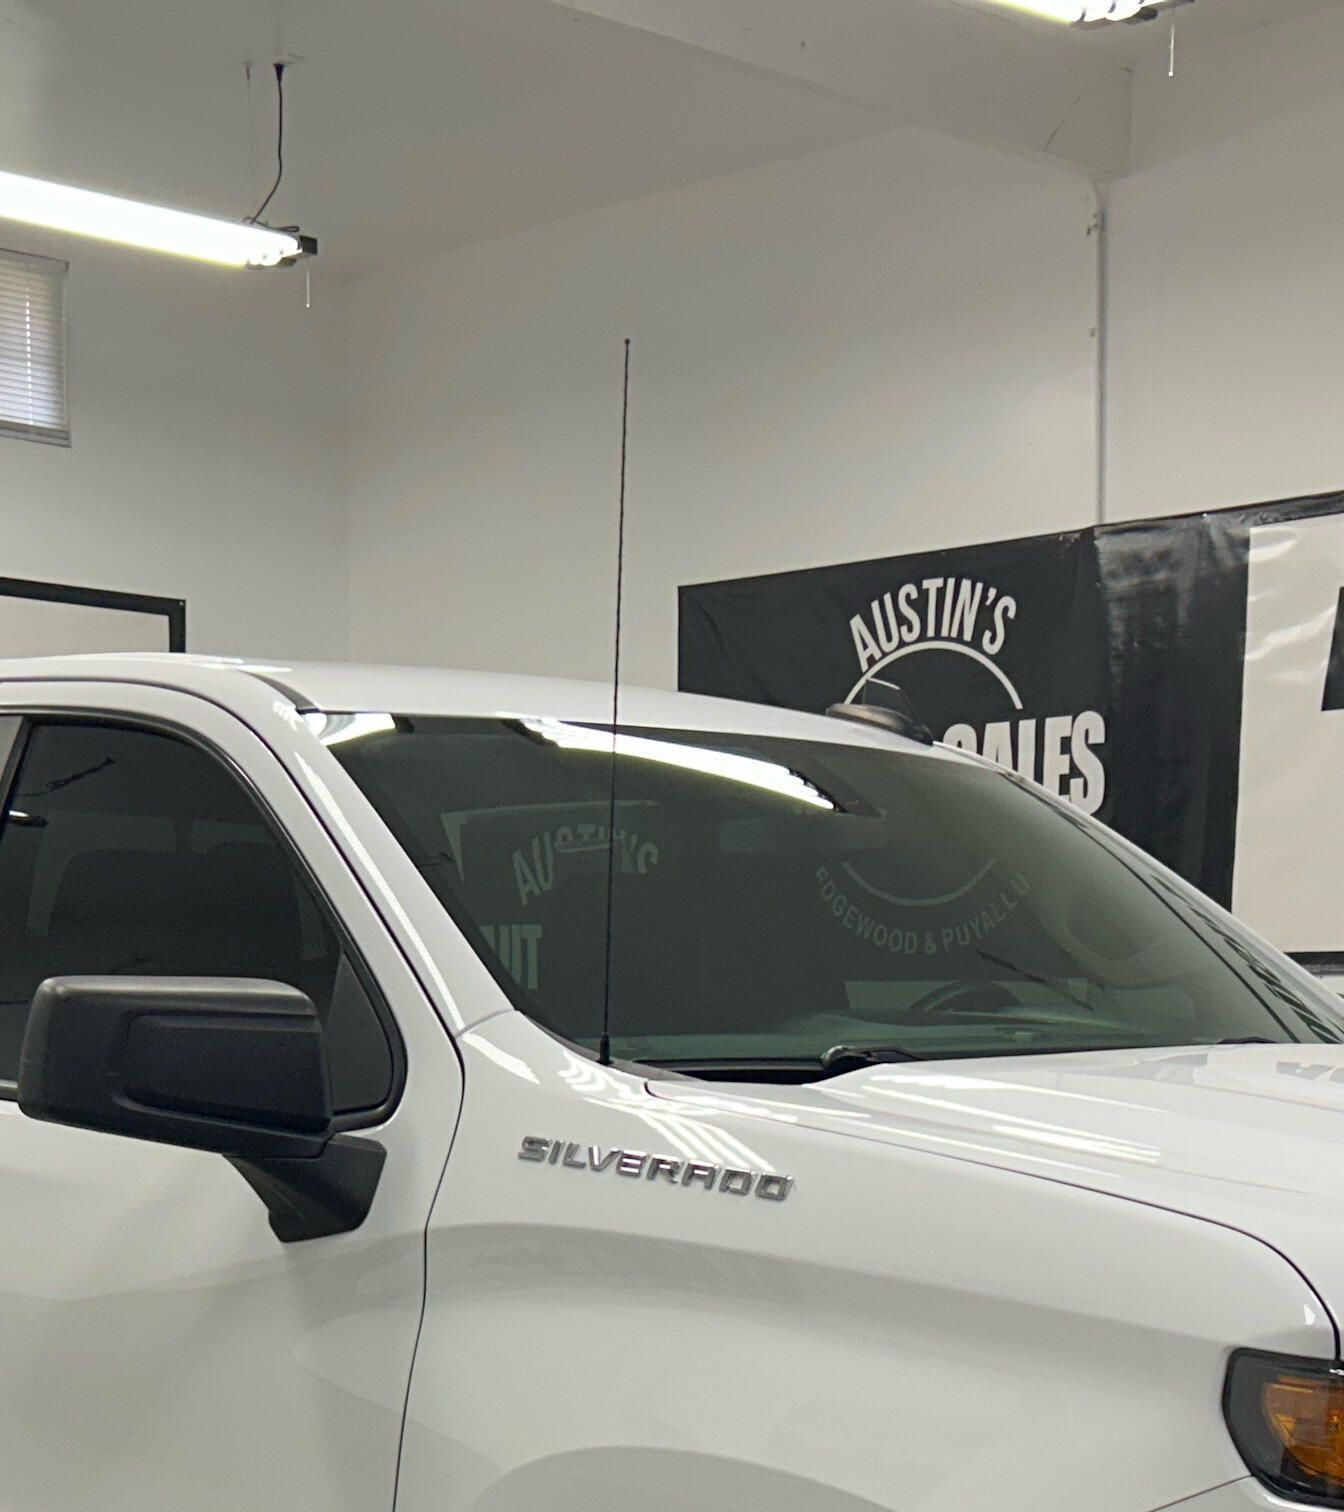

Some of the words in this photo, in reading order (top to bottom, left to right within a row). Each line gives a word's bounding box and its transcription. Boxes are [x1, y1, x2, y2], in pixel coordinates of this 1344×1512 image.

[849, 577, 1016, 674] AUSTIN'S
[924, 932, 937, 954] &
[518, 1136, 794, 1201] SILVERADO
